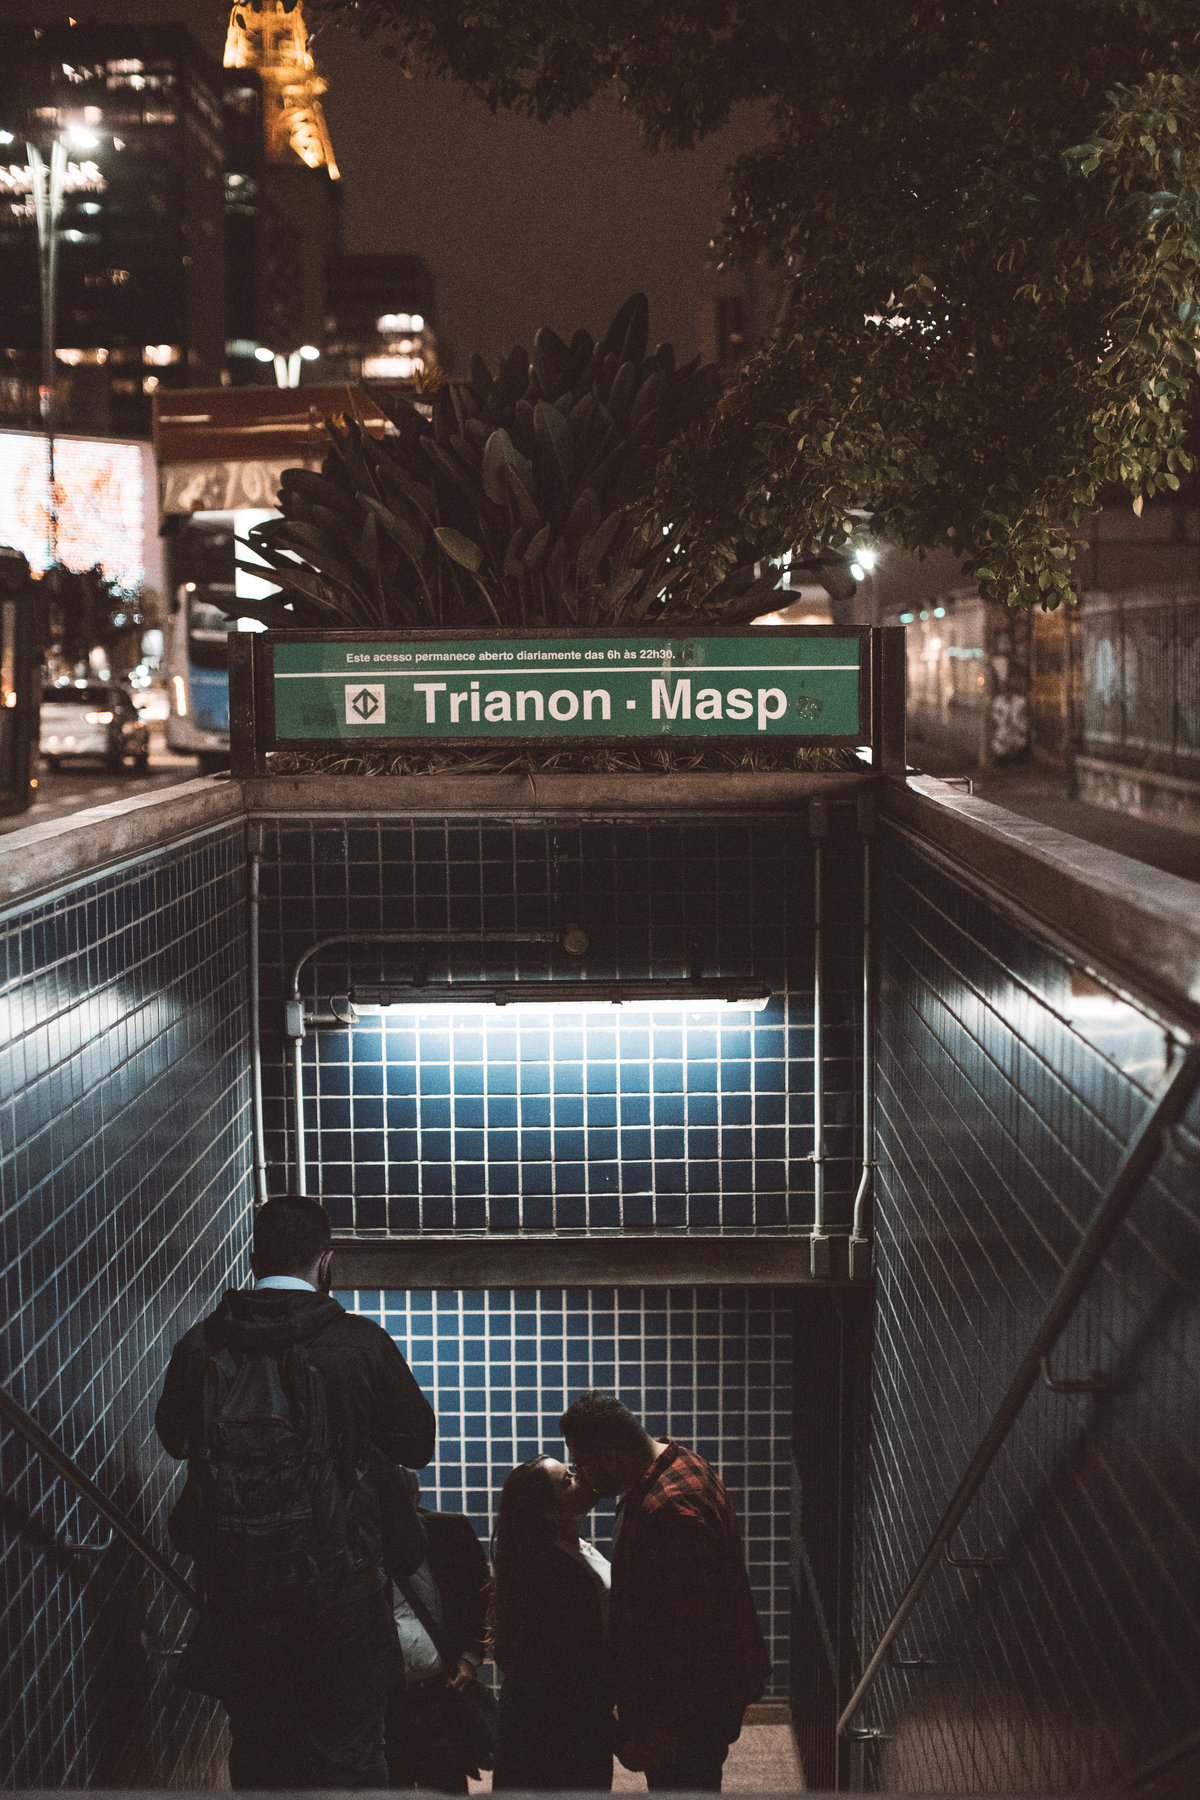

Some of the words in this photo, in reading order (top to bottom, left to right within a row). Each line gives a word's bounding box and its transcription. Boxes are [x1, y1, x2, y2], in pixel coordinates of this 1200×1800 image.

[346, 653, 371, 663] Este
[372, 652, 413, 662] acesso
[415, 652, 476, 664] permanece
[478, 651, 514, 661] aberto
[516, 650, 582, 661] diariamente
[584, 650, 605, 660] das
[607, 650, 621, 660] 6h
[623, 649, 637, 660] às
[639, 649, 676, 660] 22h30.
[413, 681, 611, 724] Trianon
[651, 678, 788, 731] Masp
